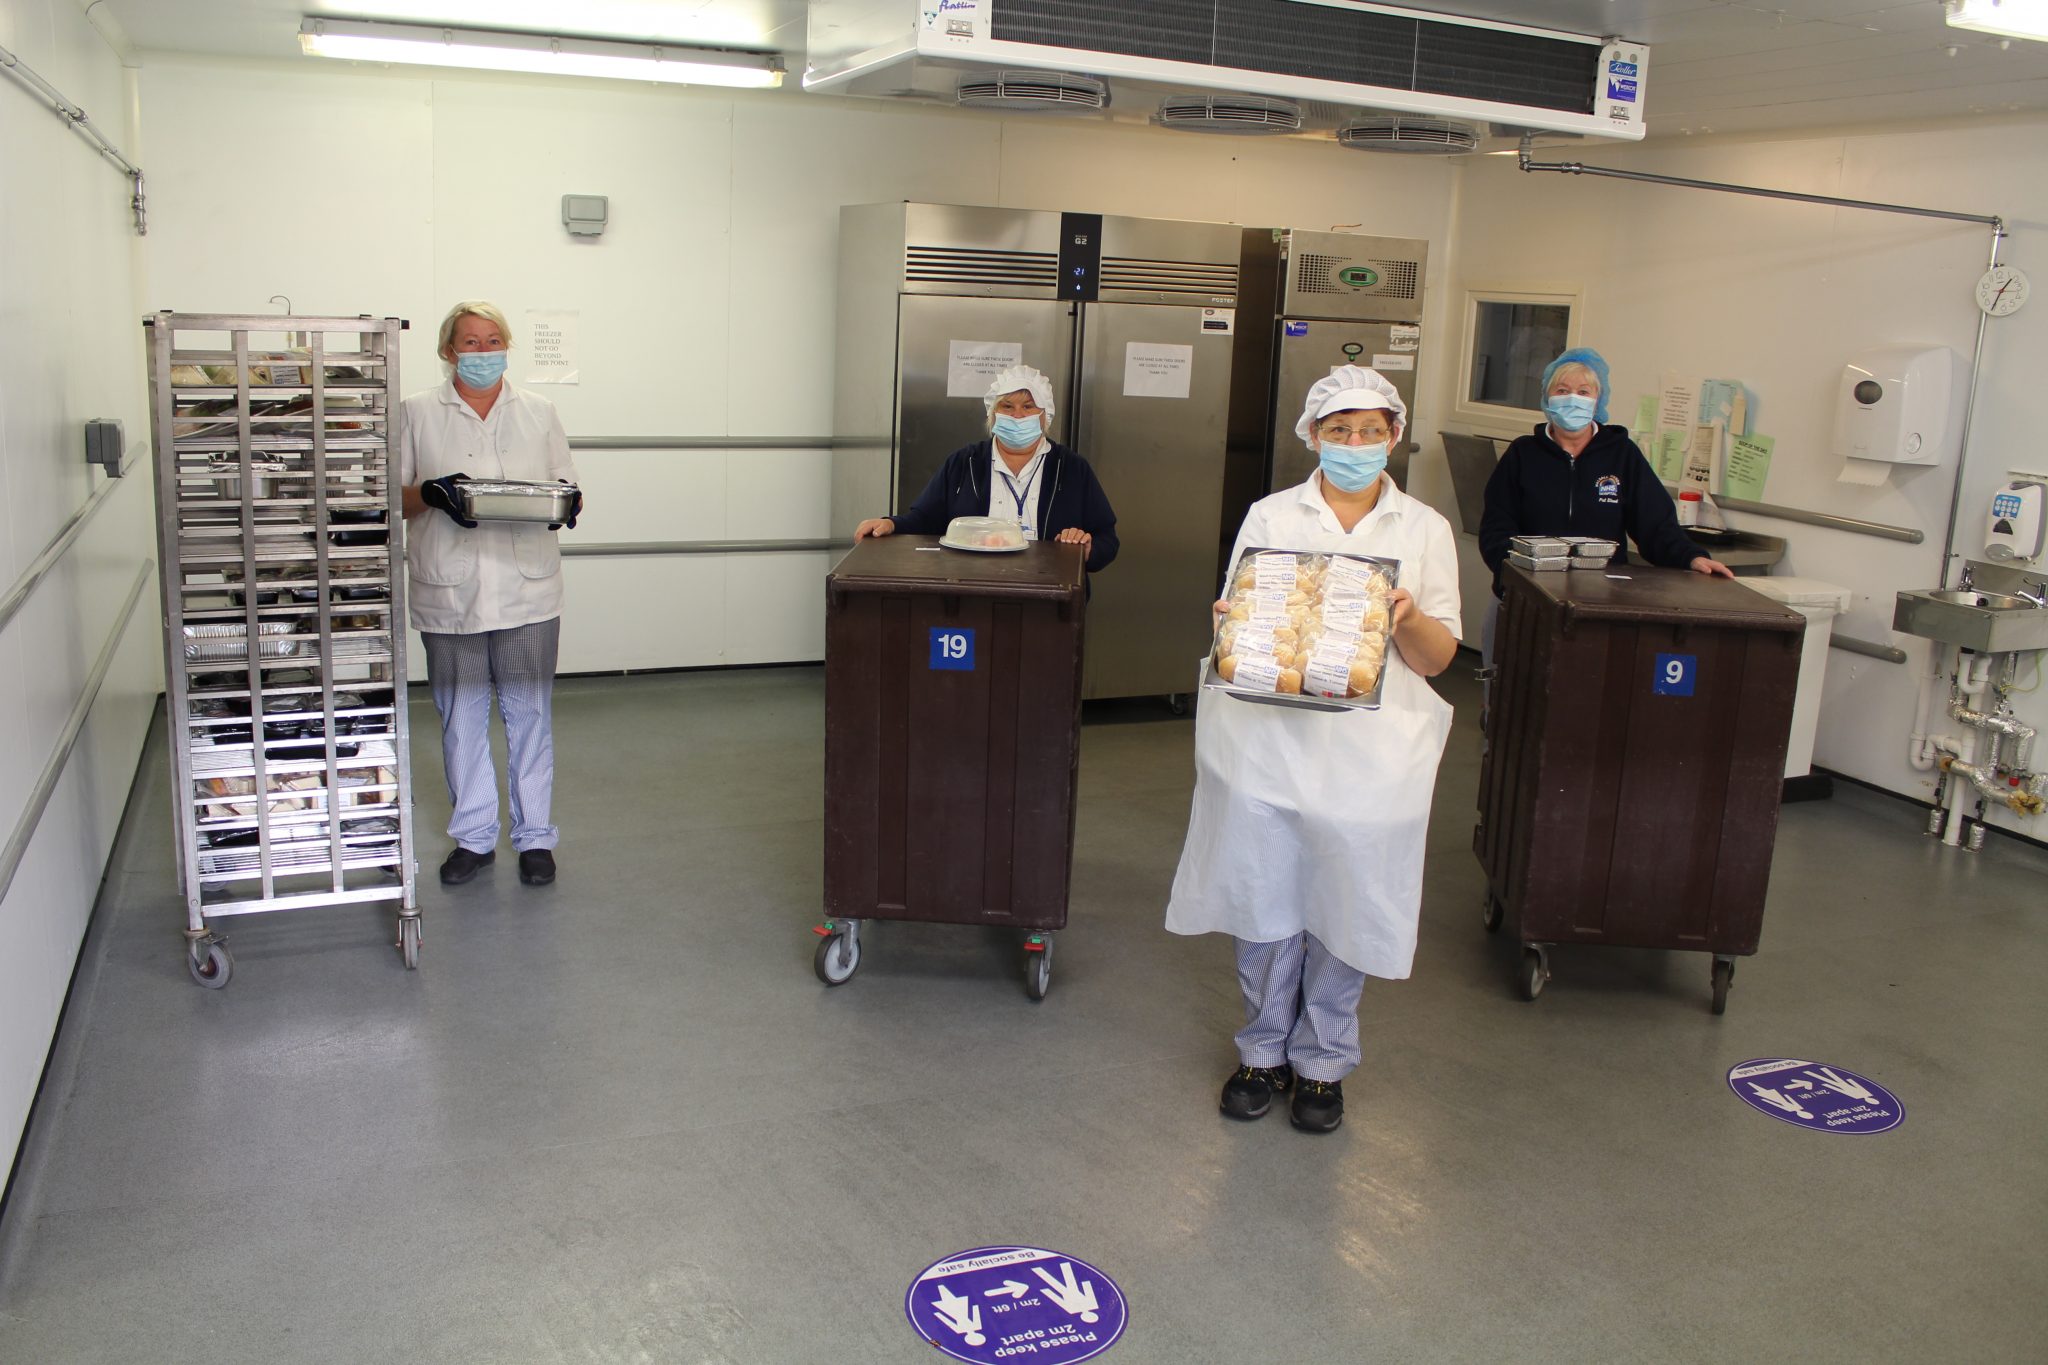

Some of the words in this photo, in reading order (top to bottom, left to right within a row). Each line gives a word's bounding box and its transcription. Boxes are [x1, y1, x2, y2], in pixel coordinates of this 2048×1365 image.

[938, 634, 967, 658] 19
[1264, 666, 1278, 675] NHS
[1335, 665, 1348, 674] NHS
[1666, 660, 1683, 684] 9
[1823, 1109, 1852, 1119] apart
[1853, 1110, 1890, 1121] Please
[1827, 1117, 1855, 1127] keep
[968, 1254, 1015, 1267] socially
[1018, 1252, 1036, 1261] Be
[938, 1262, 964, 1273] safe
[1019, 1298, 1041, 1307] 2m
[992, 1305, 1010, 1314] 6ft
[1049, 1324, 1076, 1336] 2m
[1000, 1330, 1045, 1346] apart
[1040, 1331, 1097, 1349] Please
[994, 1344, 1038, 1358] keep
